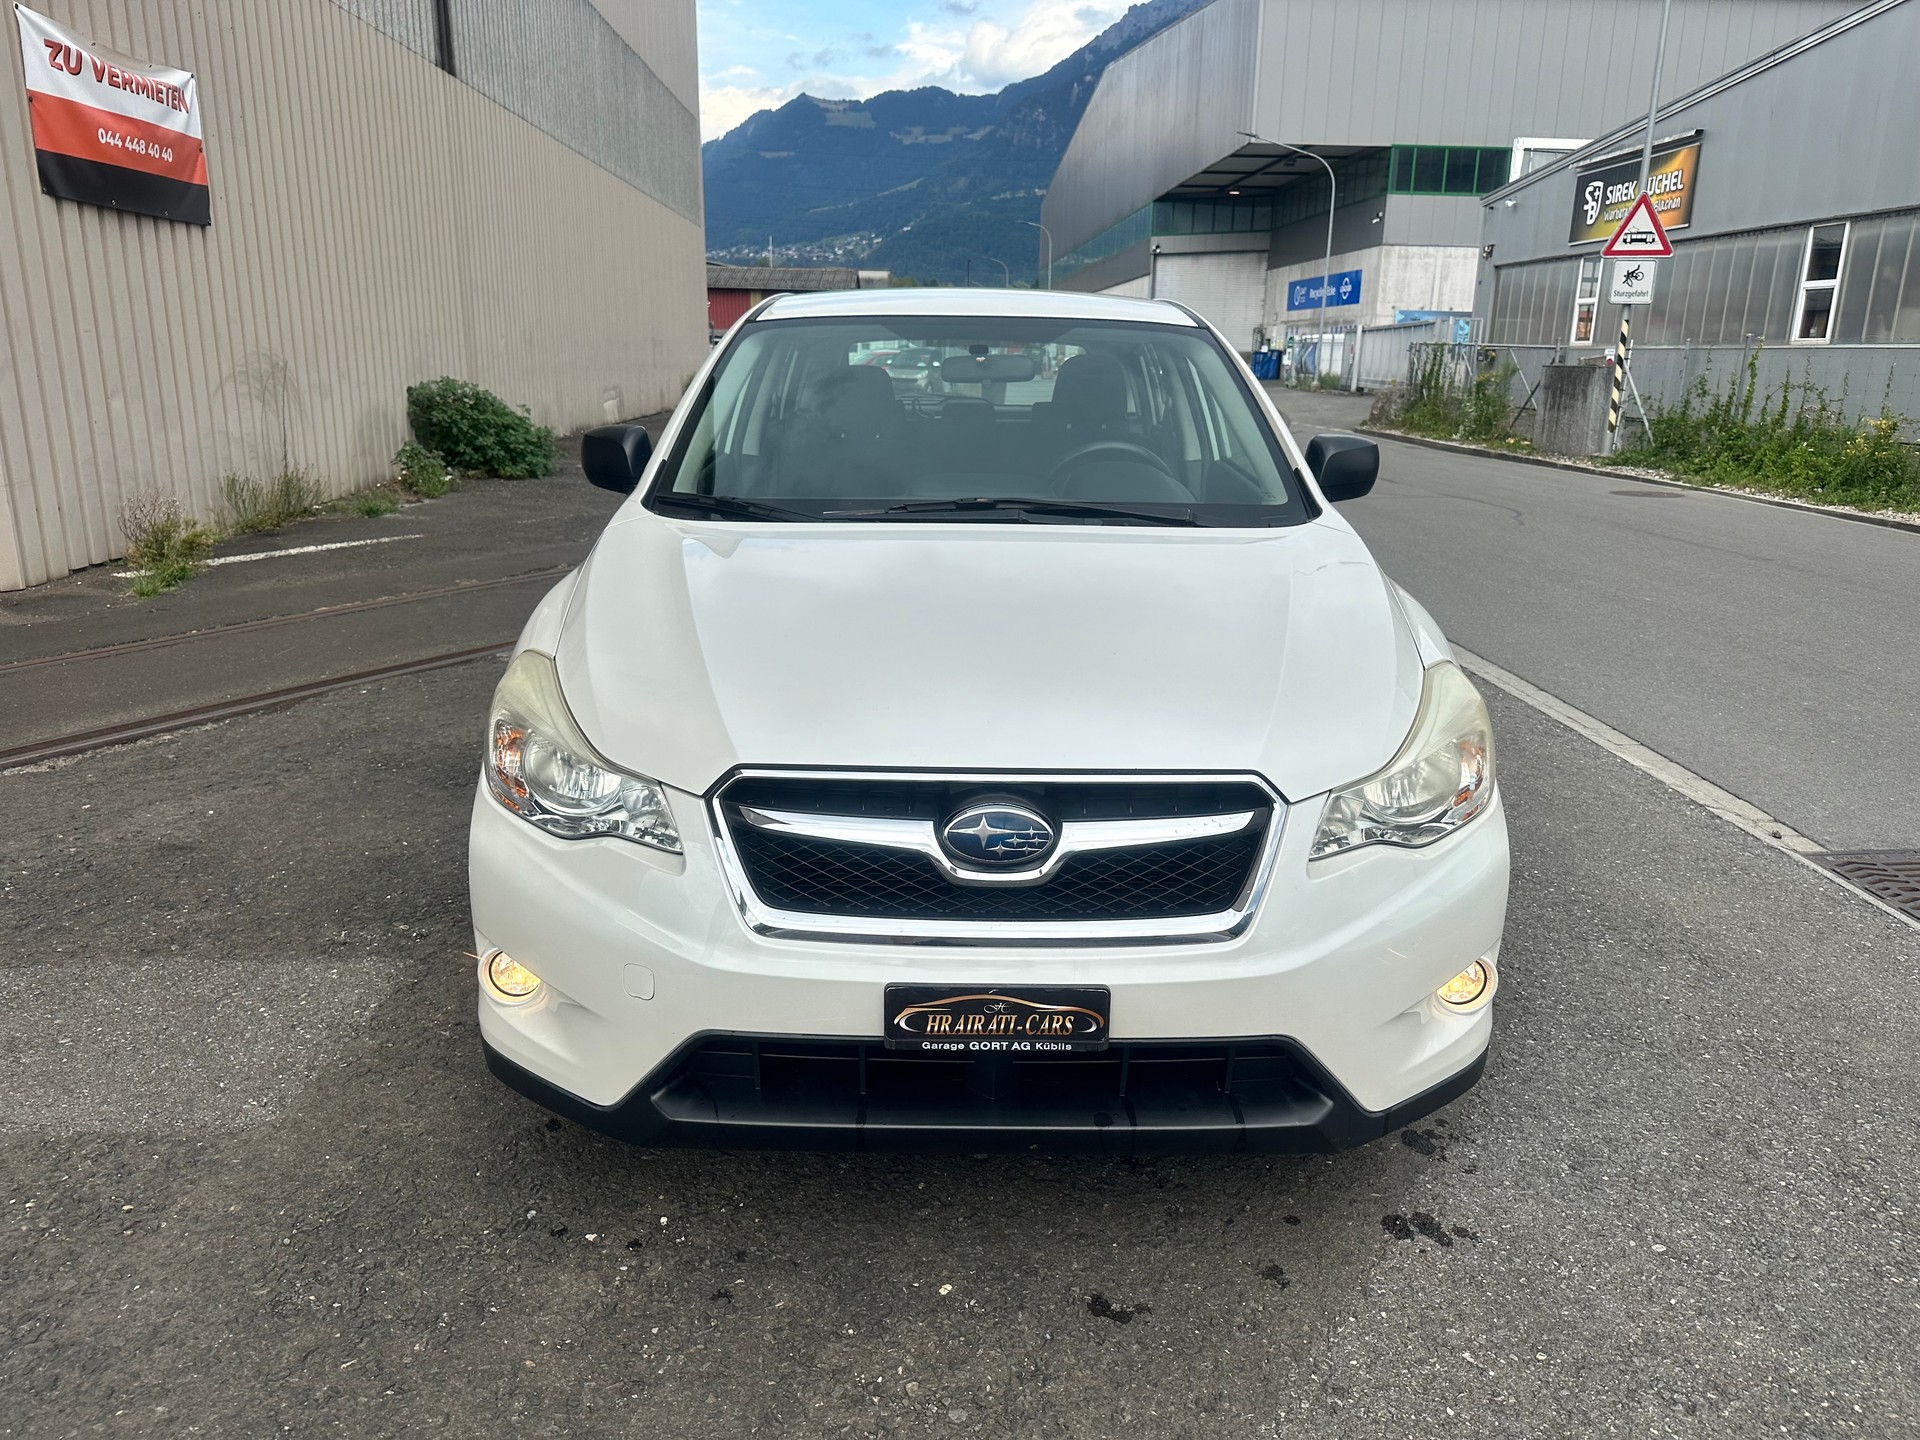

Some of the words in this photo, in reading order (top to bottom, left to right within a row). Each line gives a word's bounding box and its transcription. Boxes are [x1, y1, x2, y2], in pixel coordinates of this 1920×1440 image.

[43, 38, 83, 76] ZU
[89, 53, 190, 114] VERMIETEN
[98, 127, 123, 149] 044
[124, 135, 146, 156] 448
[147, 144, 160, 159] 40
[161, 147, 173, 163] 40
[1605, 180, 1637, 205] SIREK
[1613, 289, 1649, 299] Sturzgefahr!
[924, 1013, 1075, 1036] HRAIRATI-CARS
[922, 1041, 965, 1051] Garage
[969, 1041, 1009, 1051] GORT
[1011, 1041, 1031, 1051] AG
[1035, 1041, 1073, 1051] Küblis
